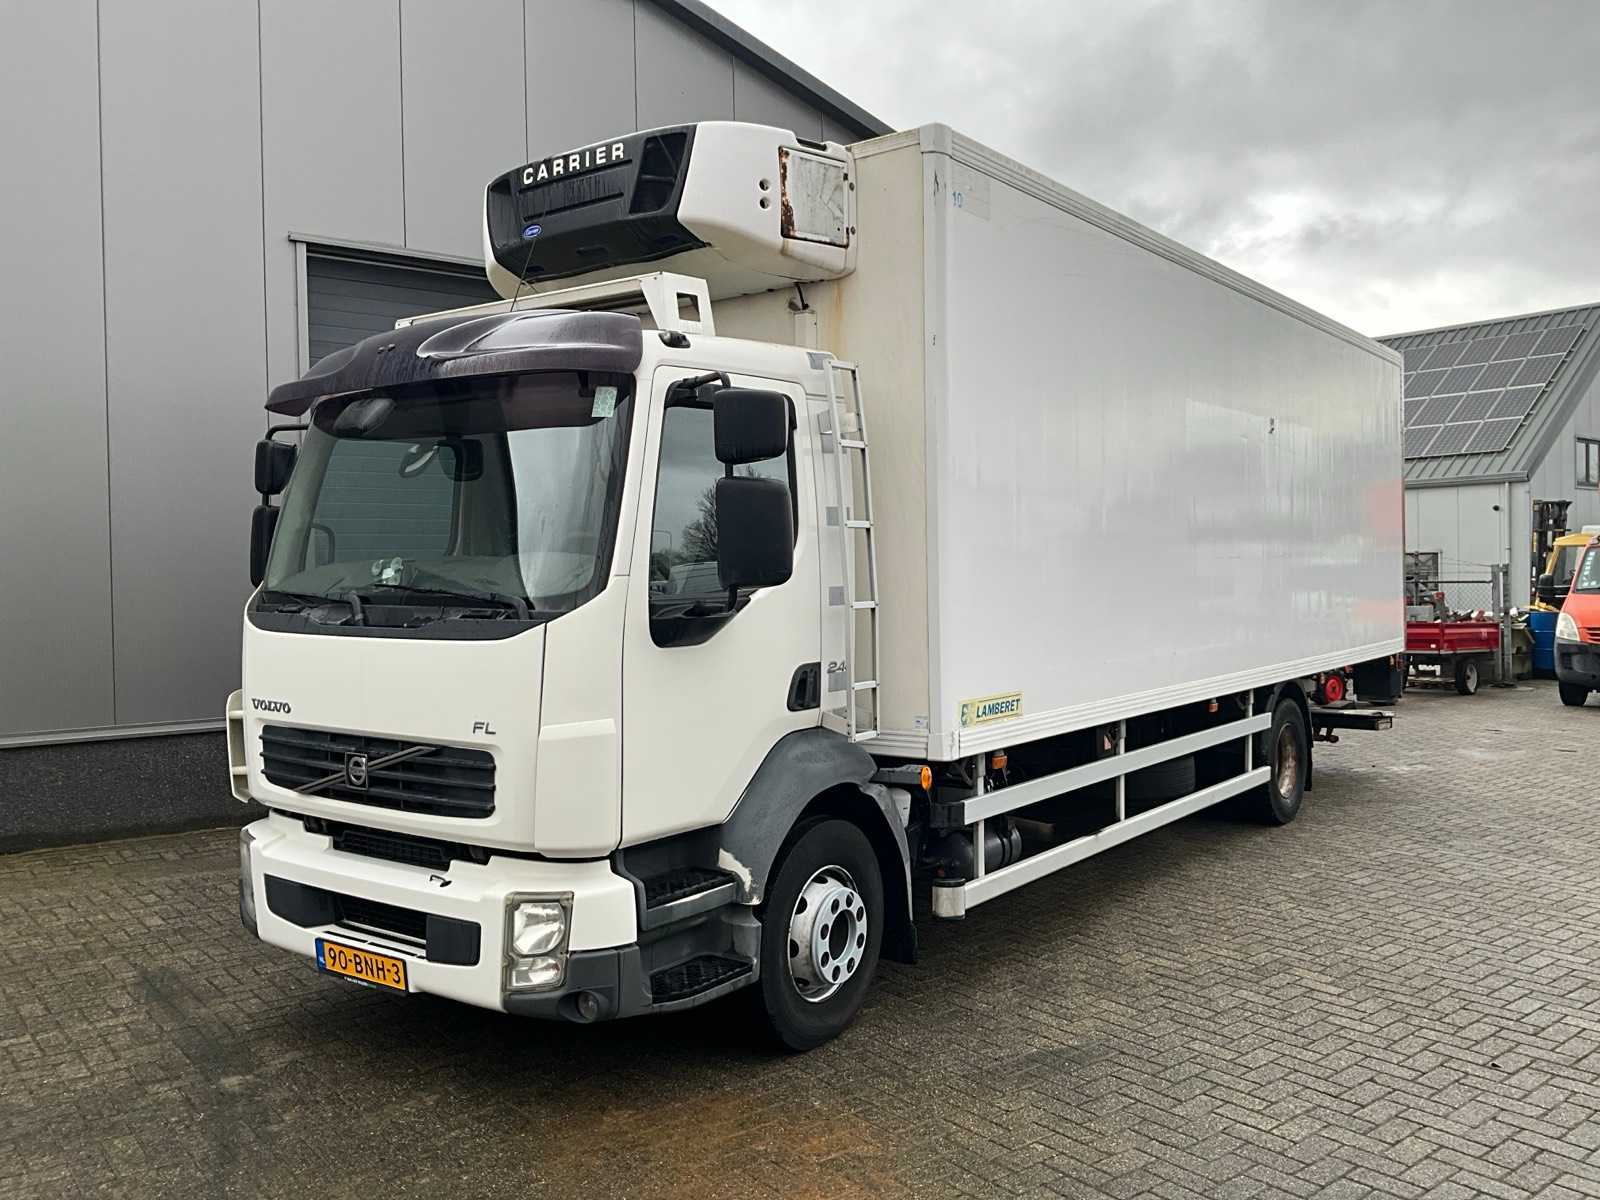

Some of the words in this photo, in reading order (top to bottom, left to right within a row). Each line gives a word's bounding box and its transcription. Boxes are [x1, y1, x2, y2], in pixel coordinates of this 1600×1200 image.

[523, 142, 624, 185] CARRIER
[251, 698, 291, 714] VOLVO
[976, 698, 1021, 718] LAMBERET
[472, 721, 497, 735] FL
[328, 946, 401, 984] 90-BNH-3
